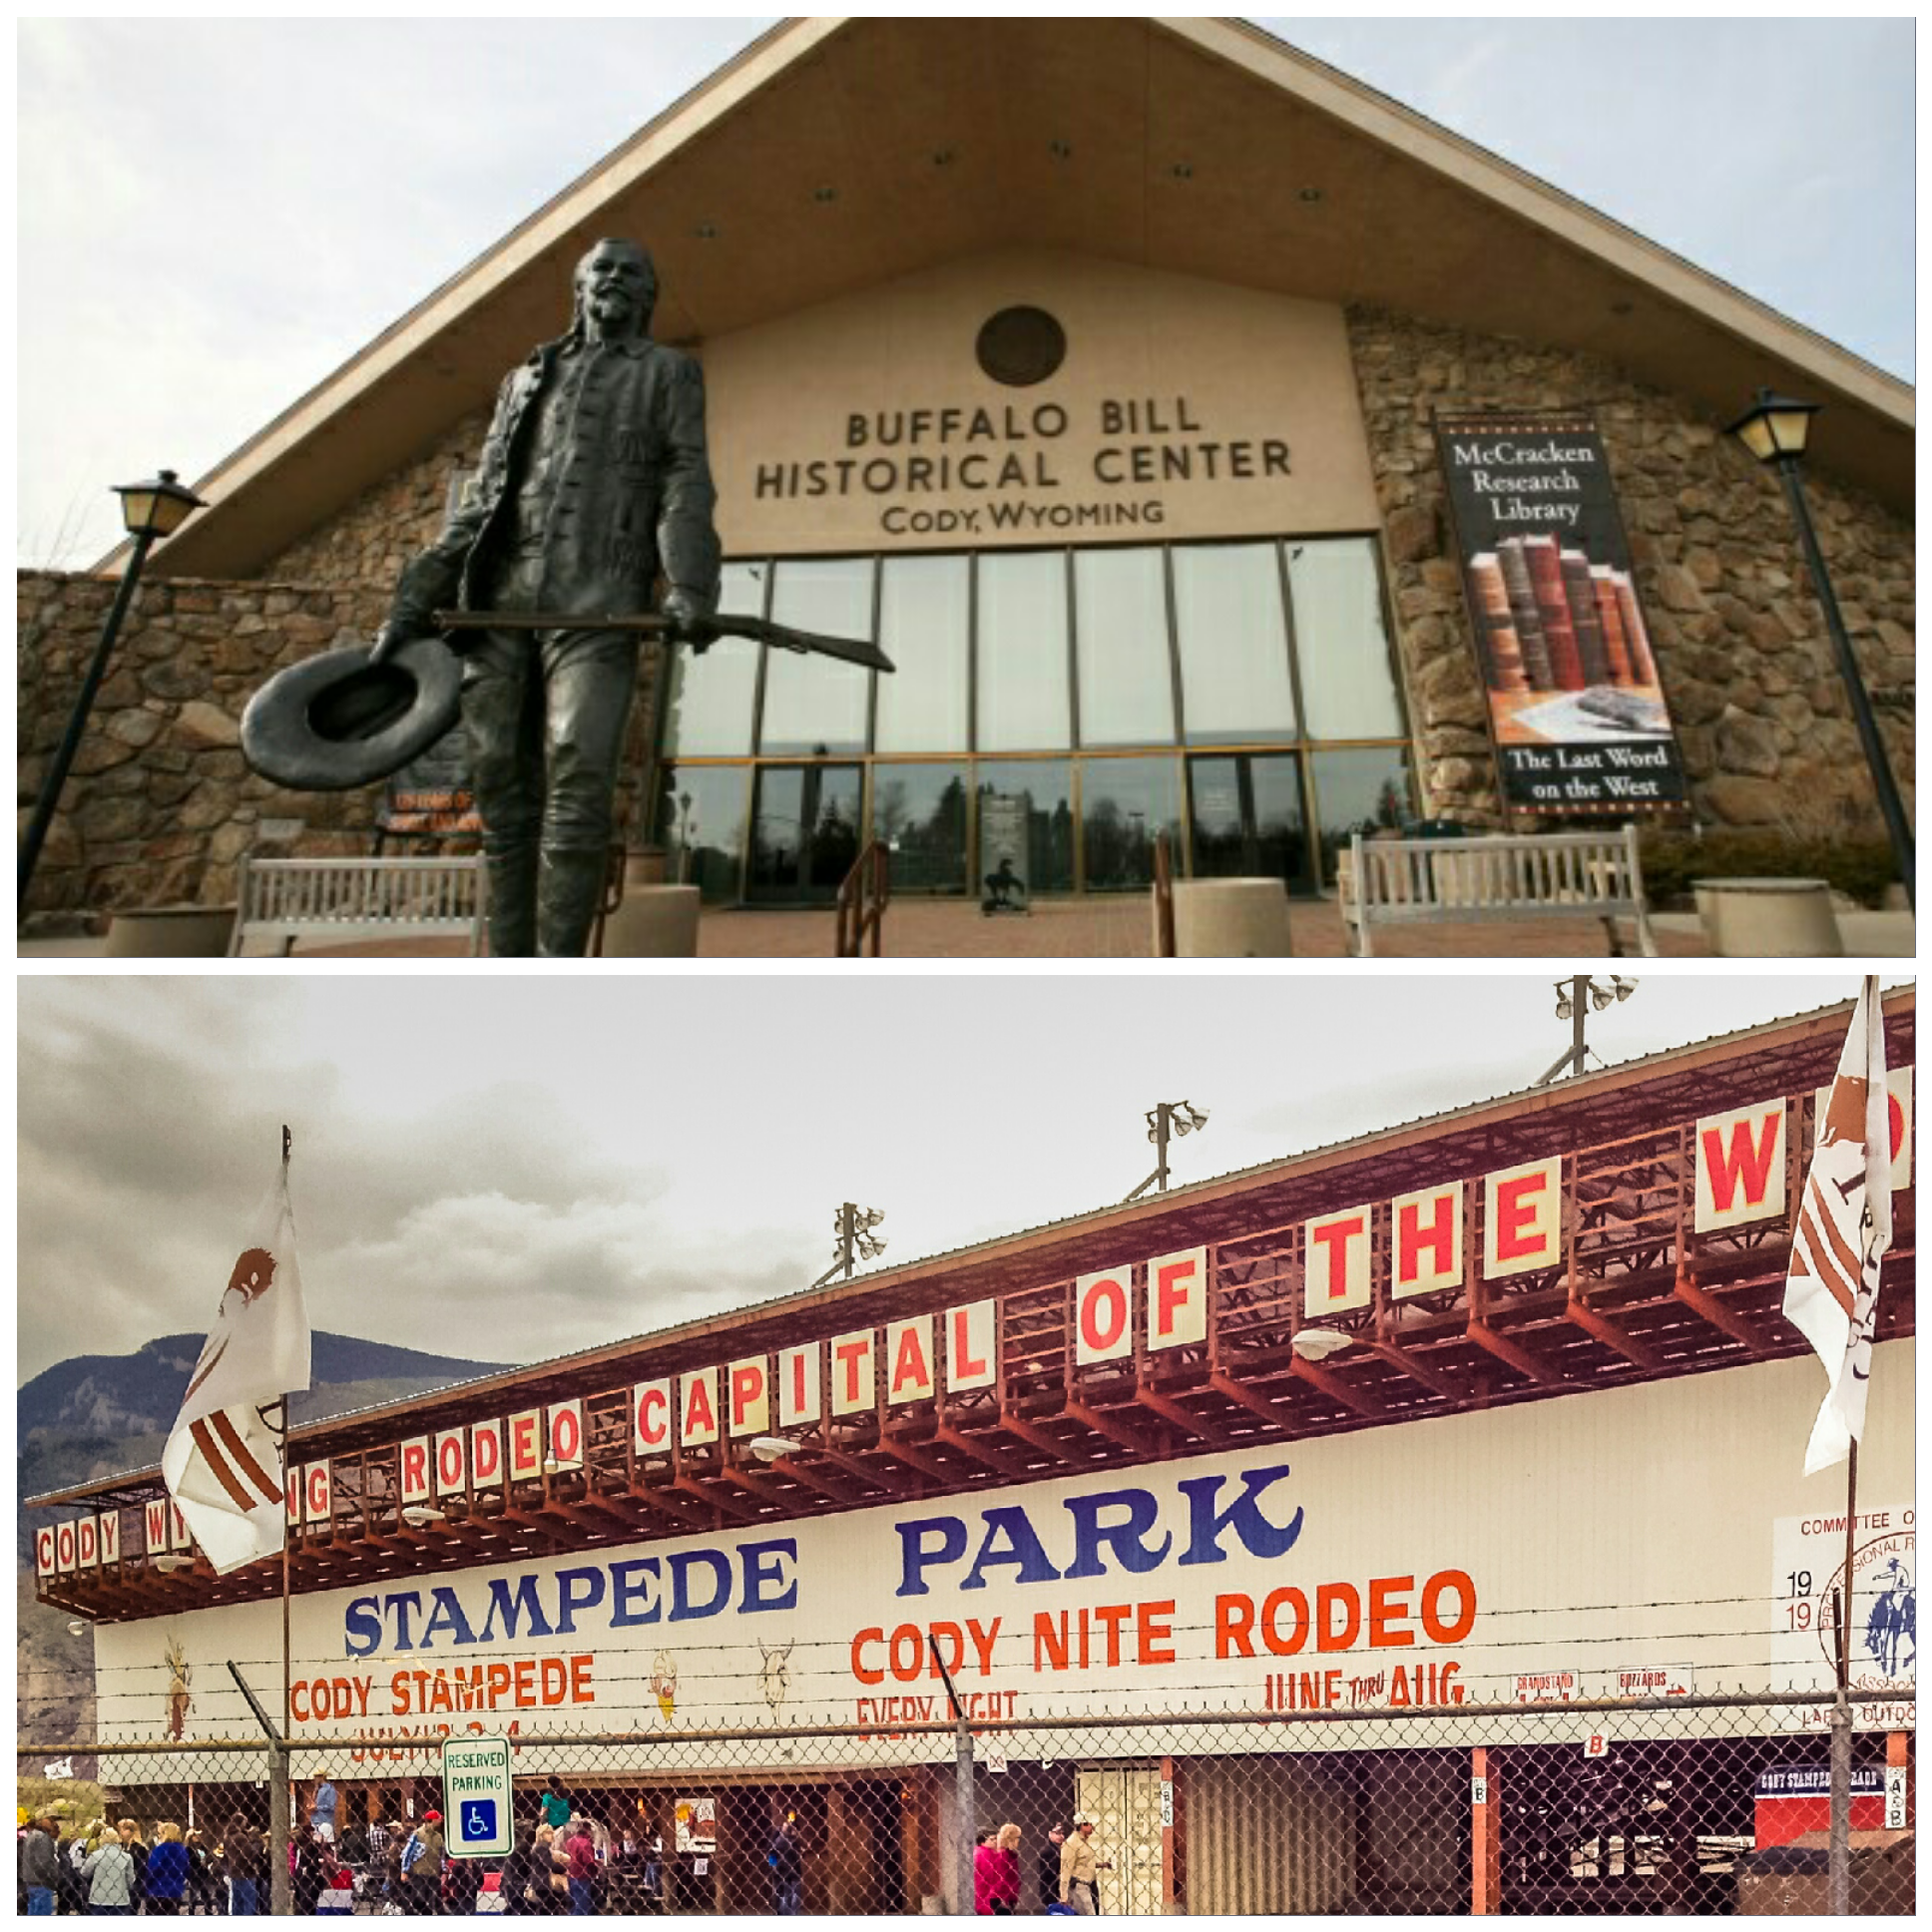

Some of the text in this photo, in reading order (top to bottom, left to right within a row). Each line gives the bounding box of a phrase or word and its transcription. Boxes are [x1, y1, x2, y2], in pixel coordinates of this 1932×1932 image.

[845, 397, 1201, 448] BUFFALO BILL
[1454, 443, 1595, 466] McCracken
[755, 440, 1292, 498] HISTORICAL CENTER
[1472, 470, 1579, 493] Research
[988, 501, 1165, 529] WYOMING
[1490, 499, 1581, 524] Library
[1509, 746, 1669, 769] The Last Word
[1533, 776, 1660, 798] on the West
[40, 1516, 116, 1569] CODY
[404, 1409, 580, 1494] RODEO
[638, 1309, 986, 1445] CAPITAL
[1080, 1259, 1196, 1349] OF
[1312, 1172, 1547, 1301] THE
[345, 1464, 1304, 1658] STAMPEDE PARK
[1787, 1571, 1812, 1597] 19
[850, 1569, 1477, 1686] CODY NITE RODEO
[1786, 1602, 1811, 1630] 19
[290, 1655, 595, 1721] CODY STAMPEDE
[1349, 1670, 1385, 1708] THRU
[1517, 1673, 1574, 1690] GRANDSTAND
[1620, 1672, 1667, 1688] BUZZARDS
[857, 1696, 934, 1741] EVERY
[1590, 1735, 1603, 1753] B
[448, 1752, 505, 1768] RESERVED
[452, 1776, 502, 1791] PARKING
[1890, 1809, 1901, 1826] B
